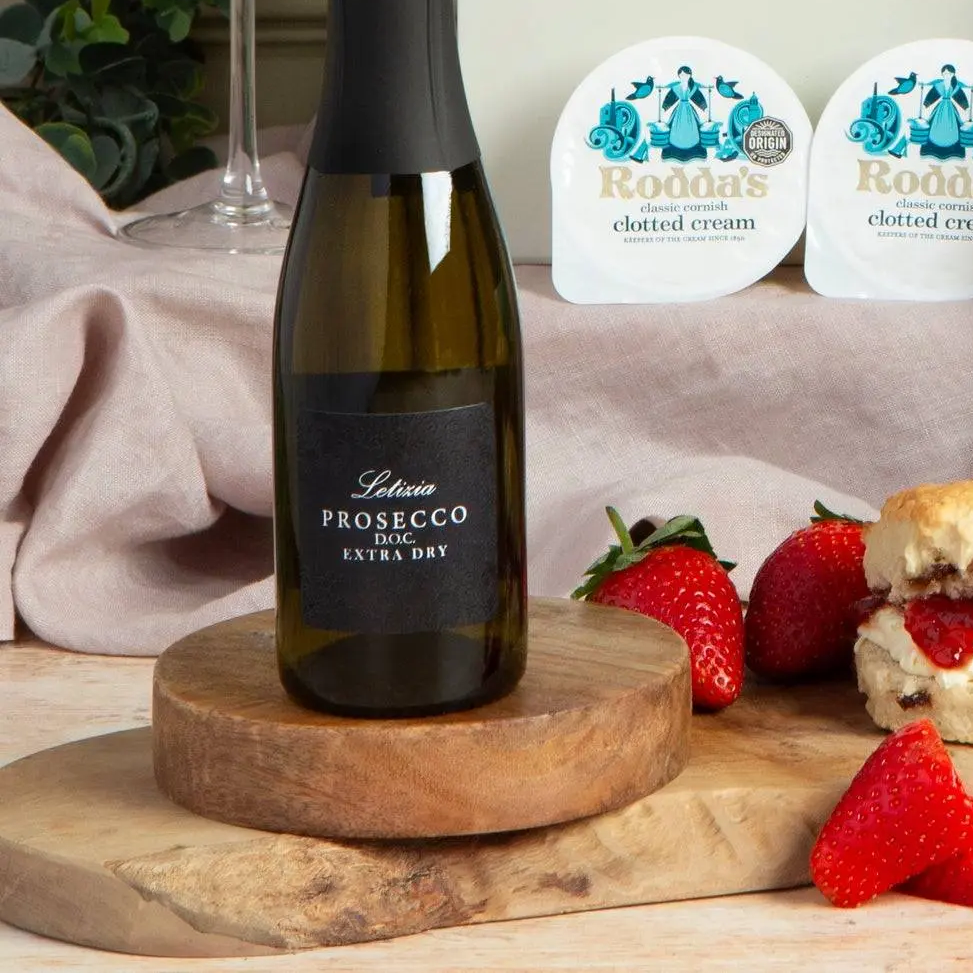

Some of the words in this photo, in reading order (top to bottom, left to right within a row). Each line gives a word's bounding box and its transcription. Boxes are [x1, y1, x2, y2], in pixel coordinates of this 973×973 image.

[749, 136, 787, 150] ORIGIN
[599, 165, 769, 200] Rodda's
[640, 201, 681, 213] classic
[683, 201, 728, 212] cornish
[896, 200, 936, 211] classic
[613, 216, 684, 233] clotted
[691, 217, 756, 230] cream
[868, 210, 938, 230] clotted
[351, 470, 438, 499] Letizia
[322, 505, 468, 530] PROSECCO
[375, 532, 416, 545] D.O.C.
[343, 547, 403, 561] EXTRA
[412, 544, 448, 561] DRY
